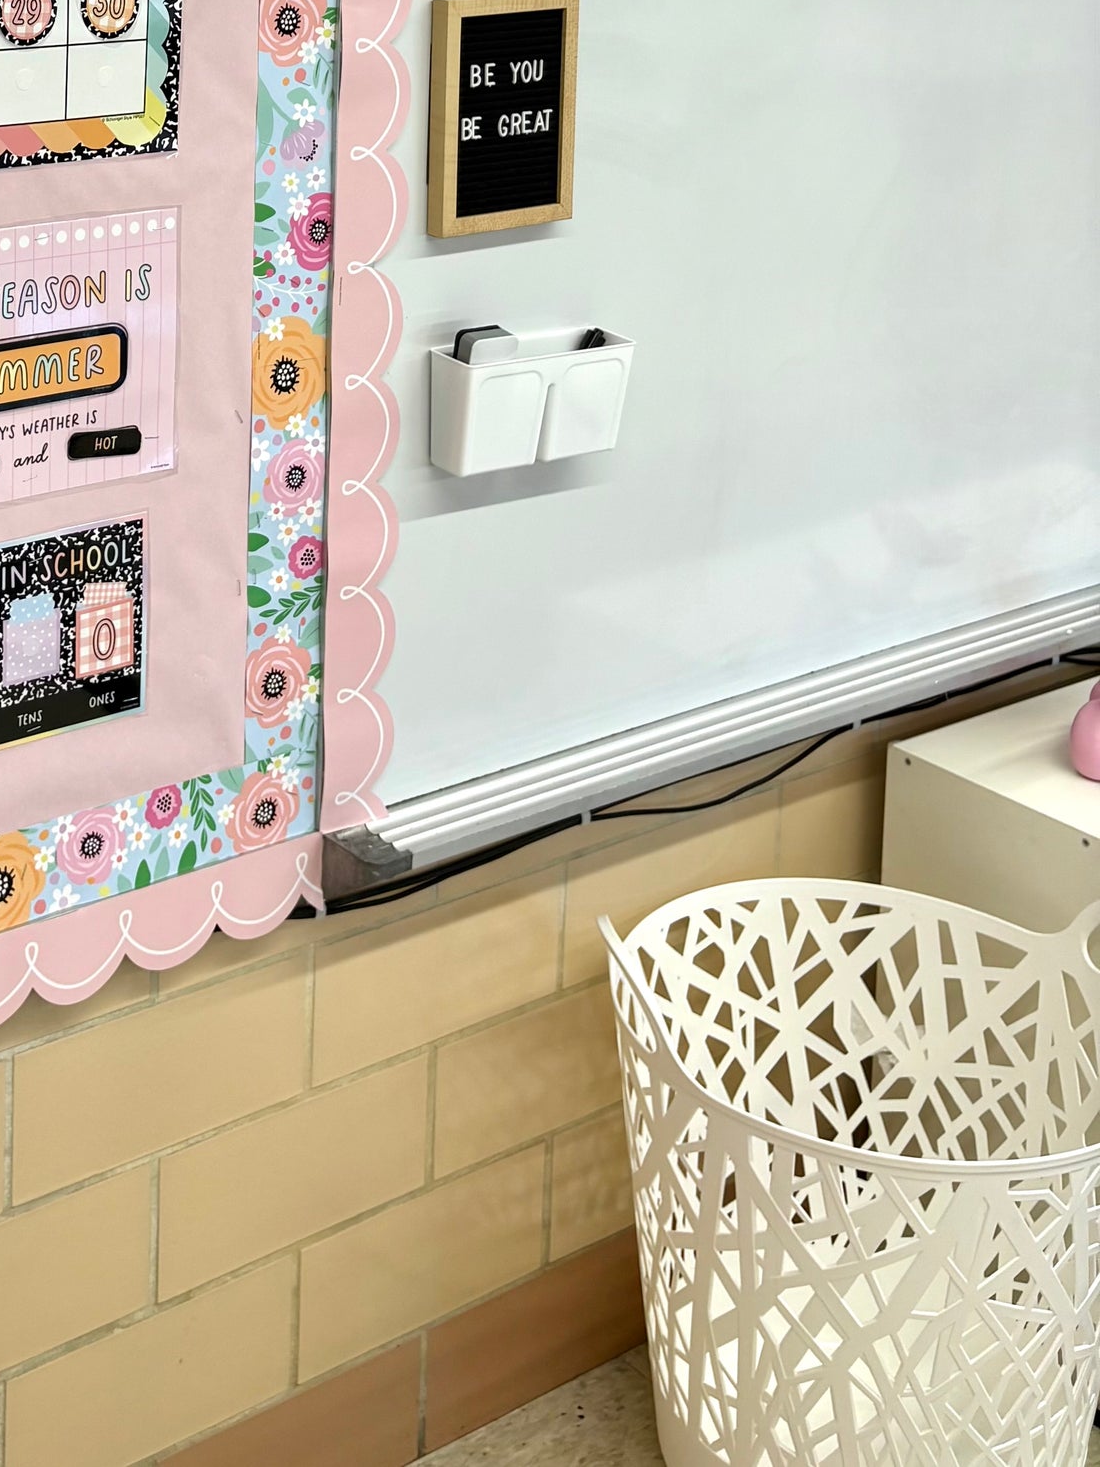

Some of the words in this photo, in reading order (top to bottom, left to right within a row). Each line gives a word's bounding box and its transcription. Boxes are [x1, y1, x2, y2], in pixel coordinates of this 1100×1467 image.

[470, 63, 496, 87] BE
[510, 59, 544, 84] YOU
[461, 116, 482, 141] BE
[498, 109, 553, 137] GREAT
[125, 263, 152, 302] IS
[22, 413, 79, 436] WEATHER
[86, 410, 97, 424] IS
[13, 443, 49, 468] and
[94, 435, 118, 451] HOT
[1, 561, 27, 591] IN
[40, 539, 131, 582] SCHOOL
[92, 617, 116, 660] 0
[88, 690, 116, 708] ONES
[17, 710, 43, 727] TENS
